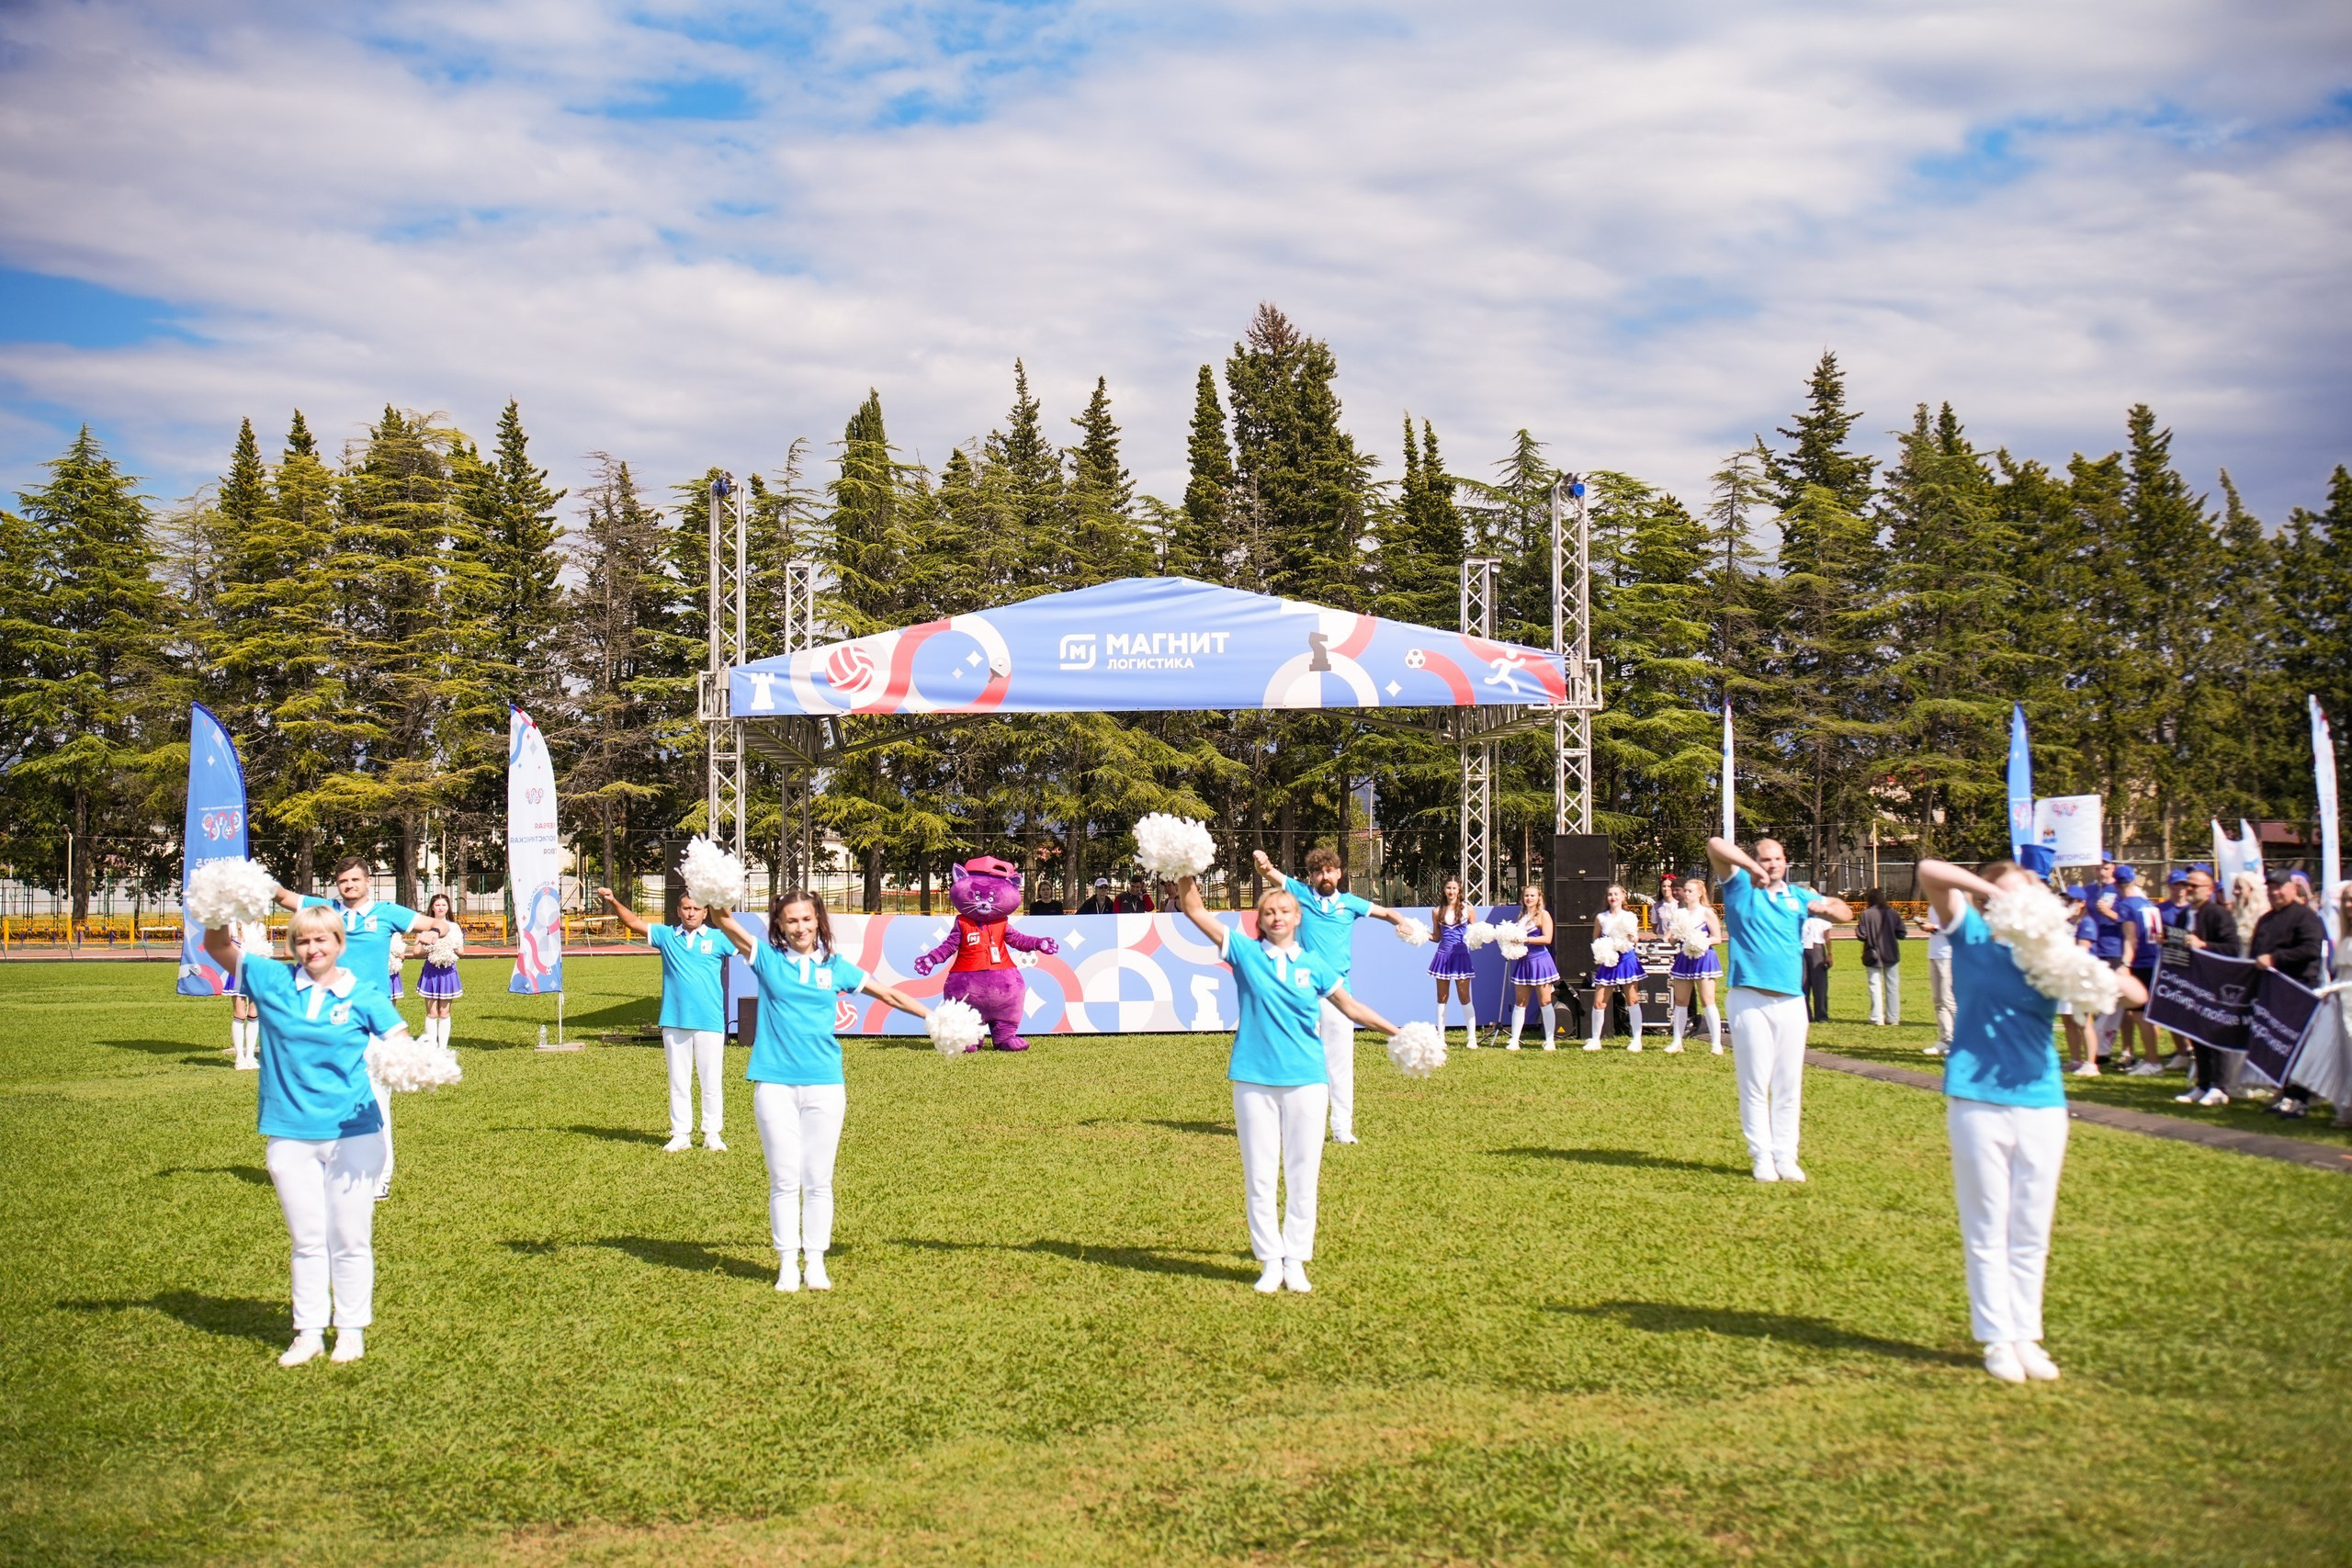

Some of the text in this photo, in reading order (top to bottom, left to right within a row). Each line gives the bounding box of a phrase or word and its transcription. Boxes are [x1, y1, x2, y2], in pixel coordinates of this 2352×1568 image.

[1106, 632, 1230, 655] МАГНИТ
[1107, 657, 1195, 670] ЛОГИСТИКА
[2052, 852, 2093, 862] ОВГОРОД
